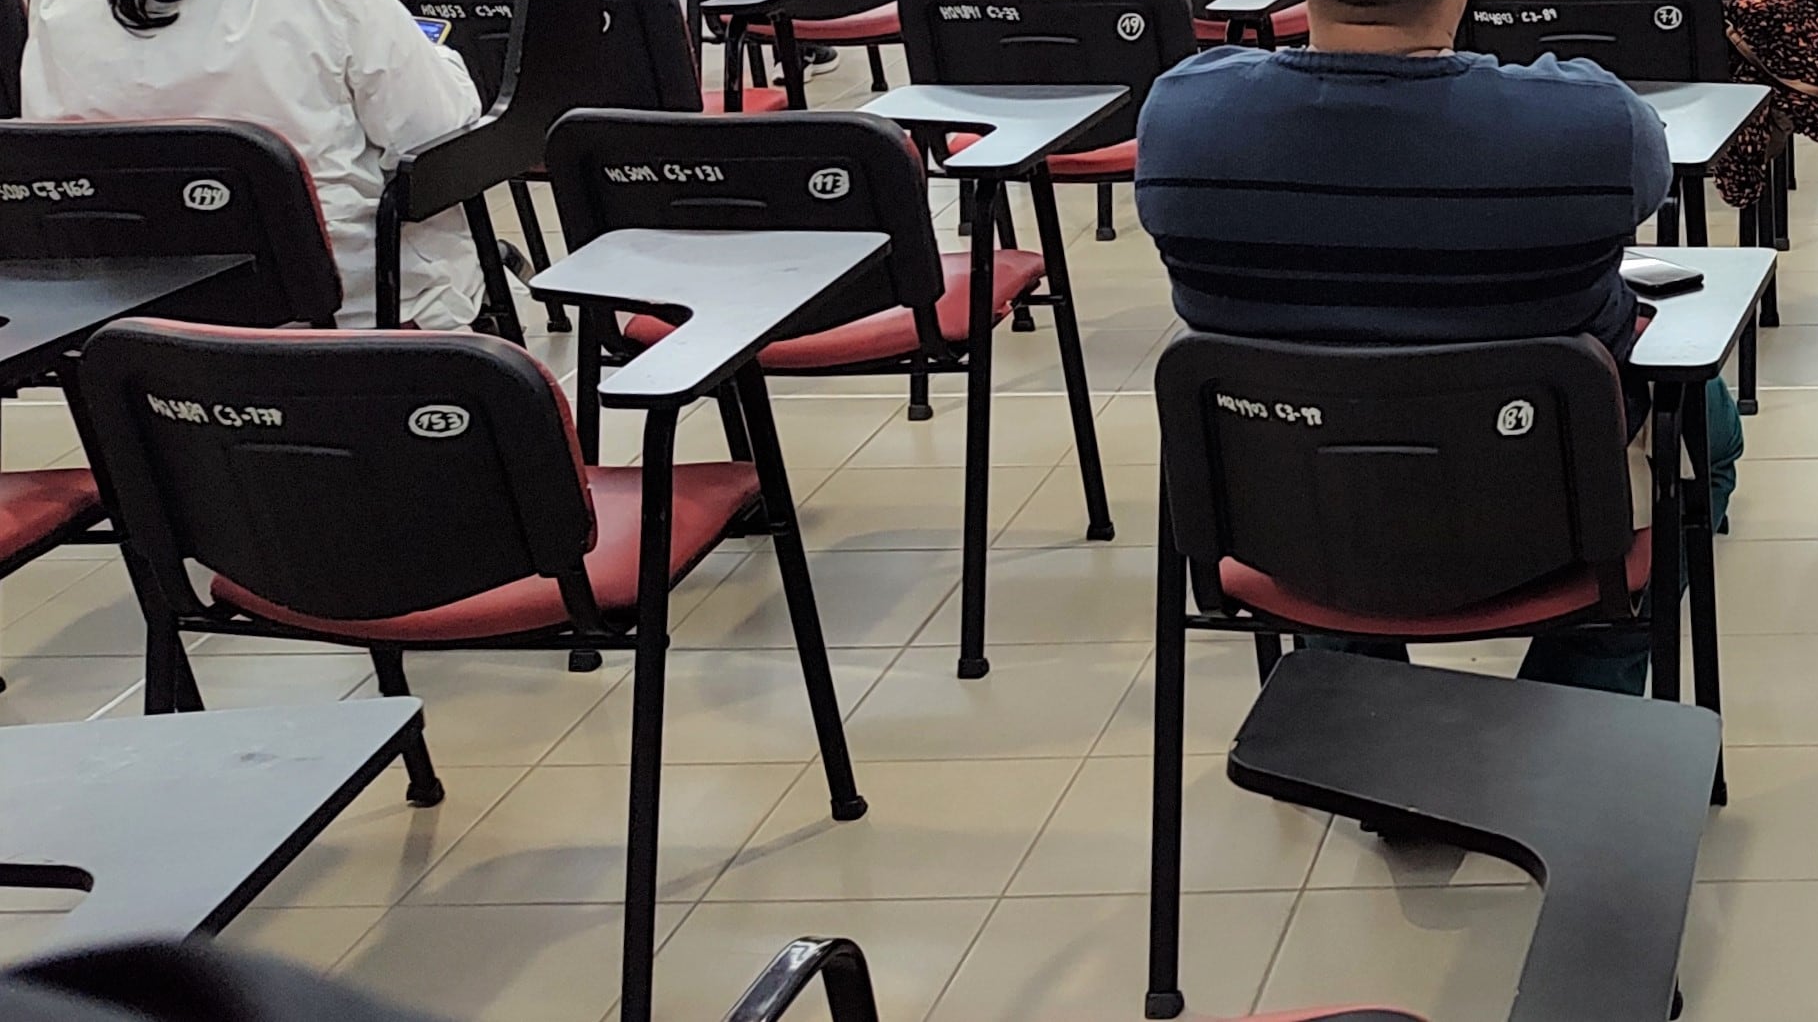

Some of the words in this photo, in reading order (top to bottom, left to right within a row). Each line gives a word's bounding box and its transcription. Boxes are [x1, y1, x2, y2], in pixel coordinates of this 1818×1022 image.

[1656, 8, 1680, 27] 71
[814, 172, 846, 195] 113
[413, 410, 464, 432] 153
[1501, 404, 1531, 430] 81
